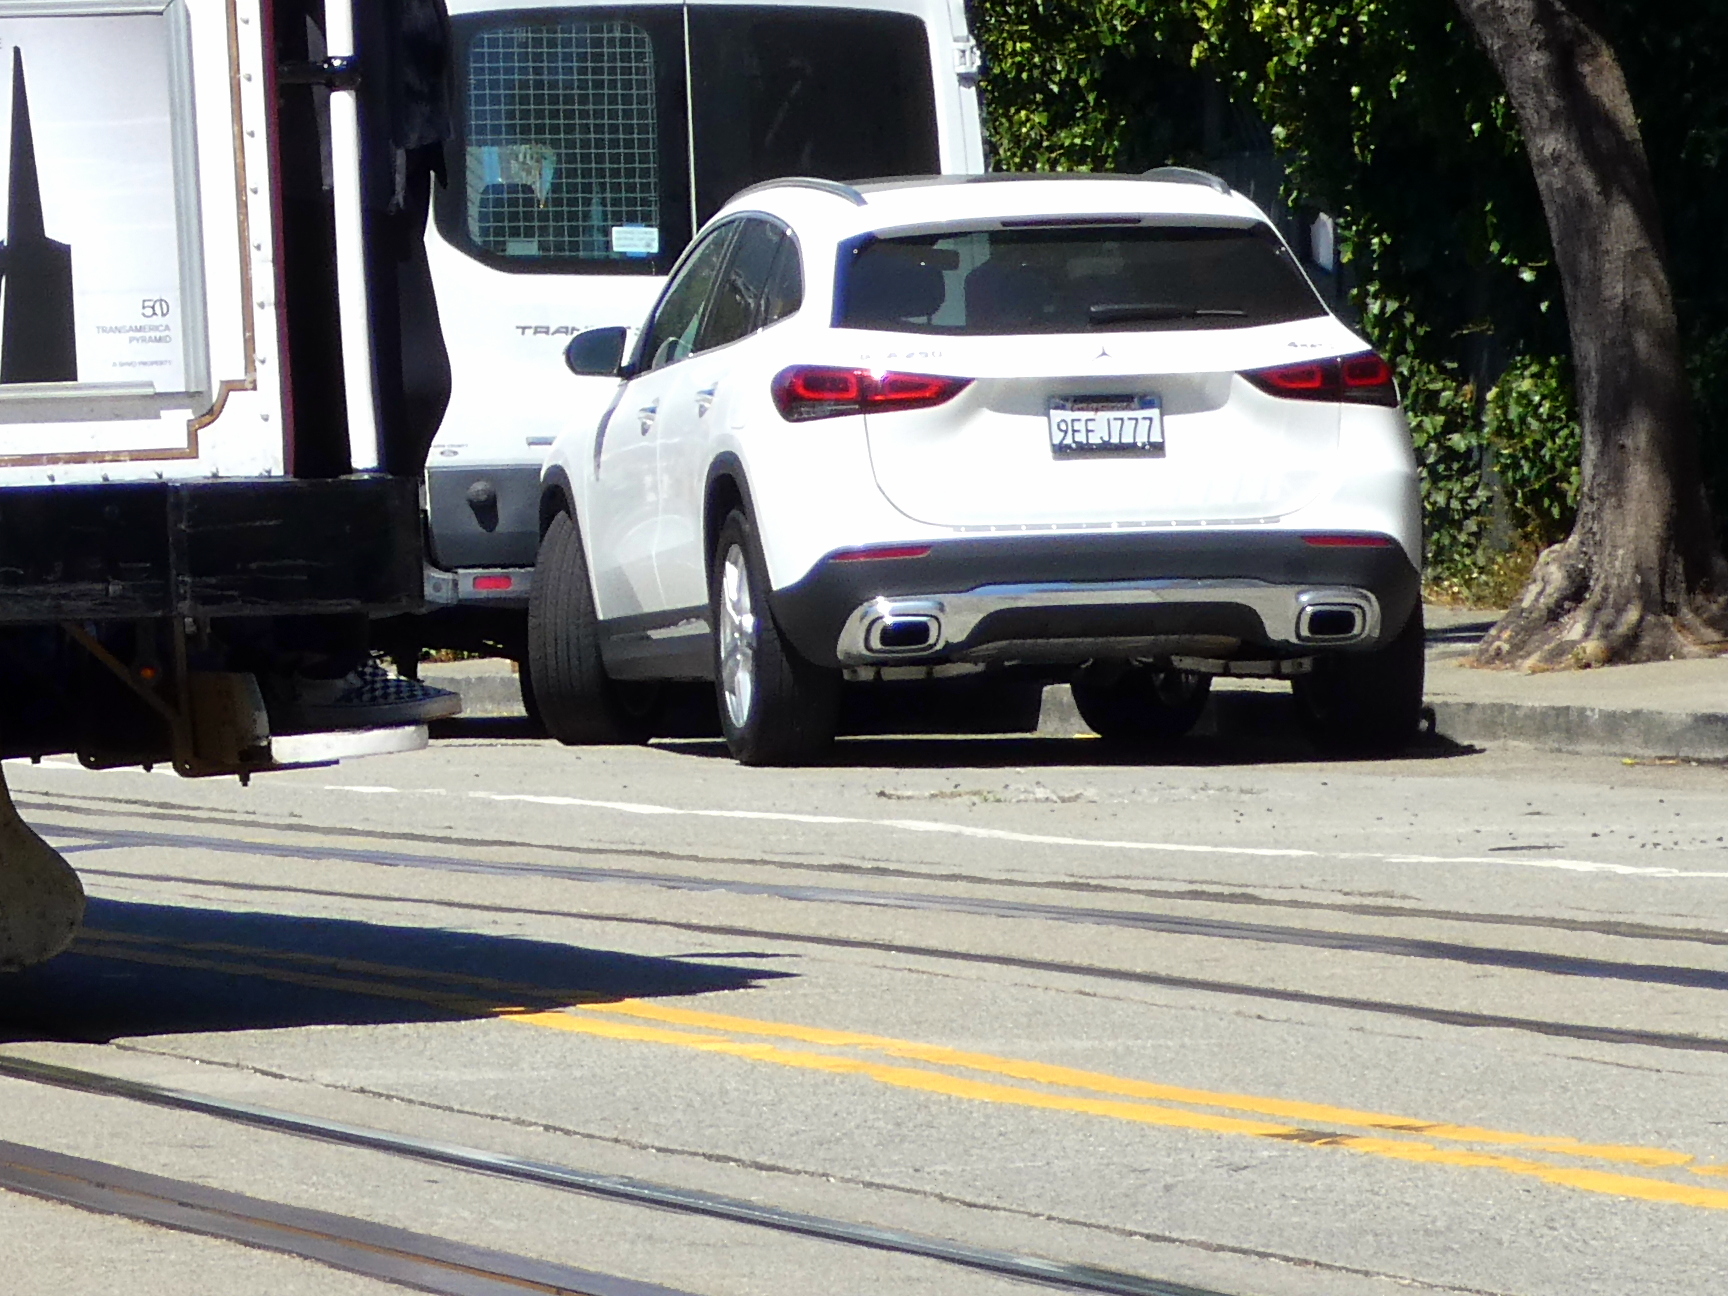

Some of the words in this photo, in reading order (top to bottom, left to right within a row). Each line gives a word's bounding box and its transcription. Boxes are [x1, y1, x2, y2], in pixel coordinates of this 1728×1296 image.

[96, 324, 171, 334] TRANSAMERICA
[128, 334, 172, 344] PYRAMID
[1056, 417, 1154, 444] 9EFJ777
